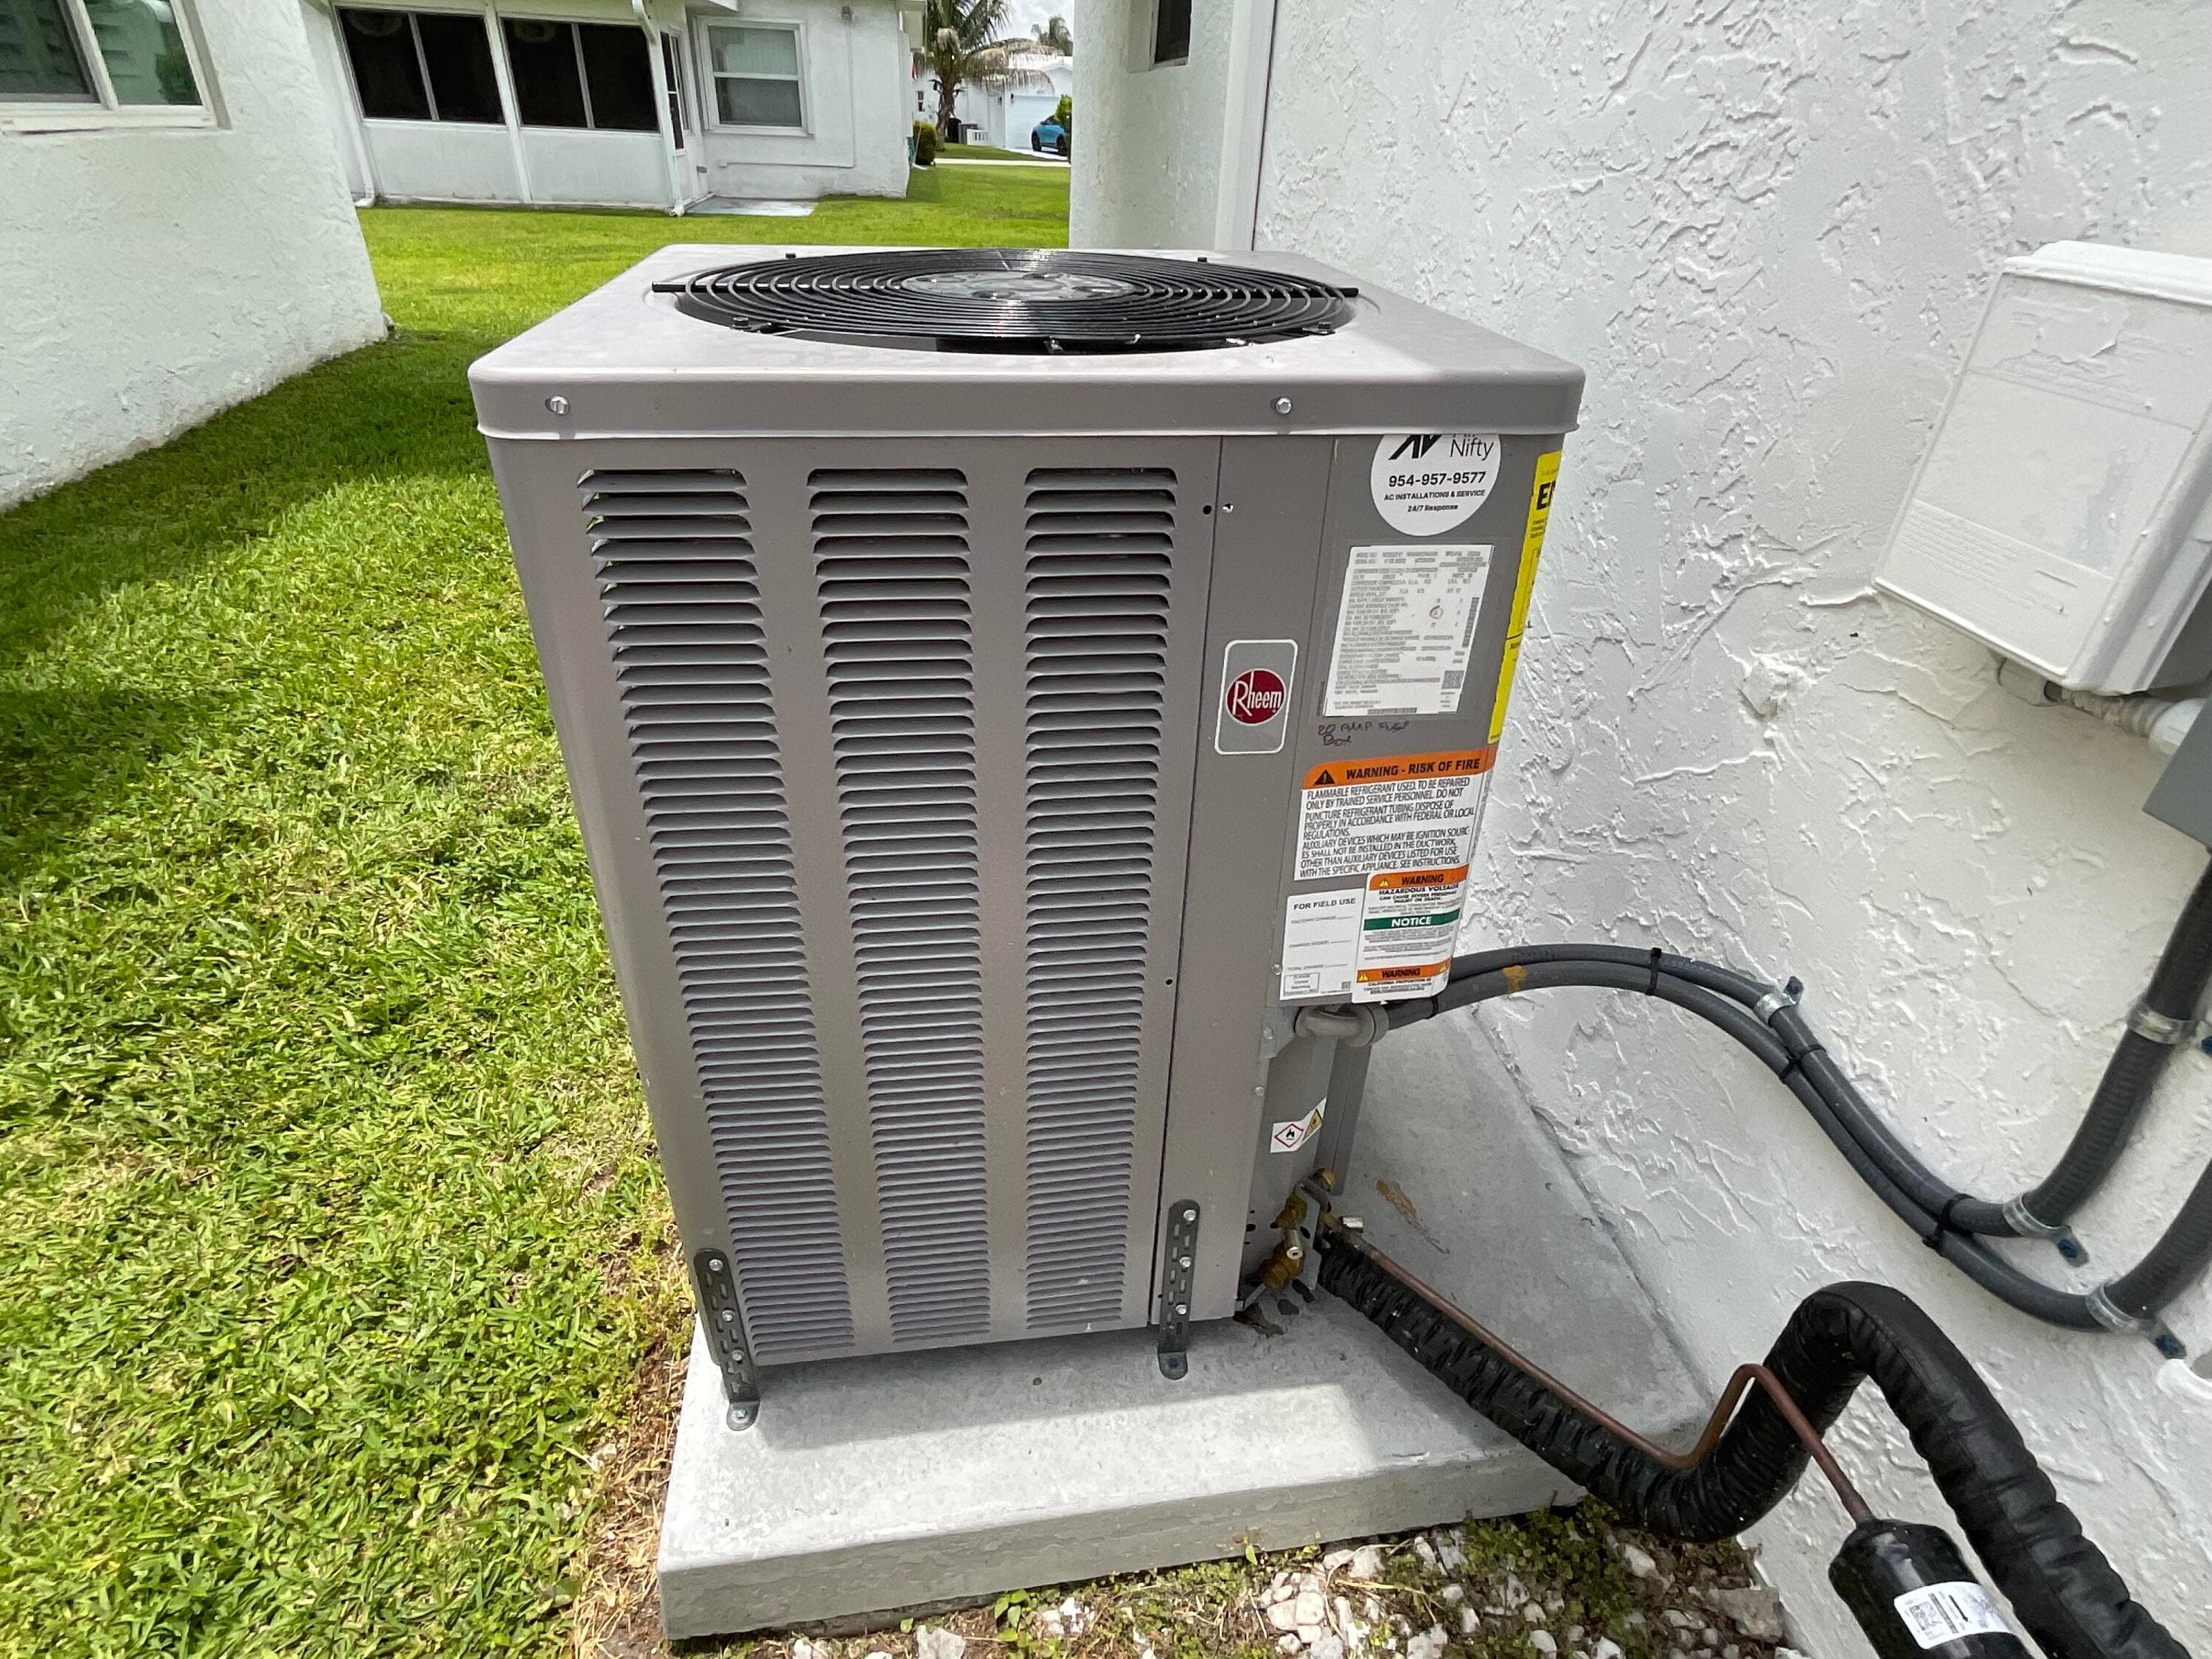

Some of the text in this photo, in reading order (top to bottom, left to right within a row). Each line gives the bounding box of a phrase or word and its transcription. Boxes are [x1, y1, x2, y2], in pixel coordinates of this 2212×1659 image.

[1450, 437, 1494, 461] Nifty
[1388, 471, 1486, 487] 954-957-9577
[1395, 491, 1449, 500] INSTALLATIONS
[1425, 504, 1458, 512] Response
[1231, 670, 1282, 717] Rheem
[1318, 724, 1336, 736] 20
[1346, 765, 1399, 779] WARNING
[1408, 762, 1436, 773] RISK
[1438, 761, 1453, 771] OF
[1455, 759, 1481, 770] FIRE
[1307, 787, 1349, 799] FLAMMABLE
[1351, 783, 1396, 796] REFRIGERANT
[1419, 781, 1427, 789] TO
[1428, 779, 1436, 788] BE
[1438, 777, 1470, 787] REPAIRED
[1307, 799, 1324, 810] ONLY
[1326, 799, 1335, 808] BY
[1336, 796, 1364, 807] TRAINED
[1366, 793, 1393, 804] SERVICE
[1436, 789, 1447, 798] DO
[1449, 787, 1464, 797] NOT
[1305, 820, 1337, 830] PROPERLY
[1348, 815, 1393, 826] ACCORDANCE
[1394, 813, 1412, 822] WITH
[1413, 811, 1441, 821] FEDERAL
[1444, 810, 1453, 818] OR
[1455, 807, 1474, 818] LOCAL
[1306, 810, 1341, 821] PUNCTURE
[1343, 805, 1388, 818] REFRIGERANT
[1416, 800, 1442, 810] DISPOSE
[1444, 800, 1454, 809] OF
[1303, 838, 1337, 850] AUXILIARY
[1338, 836, 1365, 846] DEVICES
[1366, 834, 1390, 843] WHICH
[1391, 832, 1405, 841] MAY
[1406, 832, 1414, 841] BE
[1416, 830, 1445, 840] IGNITION
[1334, 847, 1347, 855] NOT
[1357, 843, 1393, 853] INSTALLED
[1402, 841, 1415, 849] THE
[1301, 846, 1458, 869] OTHER THAN AUXILIARY DEVICES LISTED FOR USE
[1300, 868, 1317, 877] WITH
[1318, 867, 1331, 875] THE
[1332, 863, 1360, 874] SPECIFIC
[1400, 859, 1411, 868] SEE
[1401, 874, 1444, 885] WARNING
[1428, 883, 1458, 891] VOLTAGE
[1313, 900, 1337, 908] FIELD
[1391, 917, 1432, 927] NOTICE
[1382, 968, 1420, 978] WARNING
